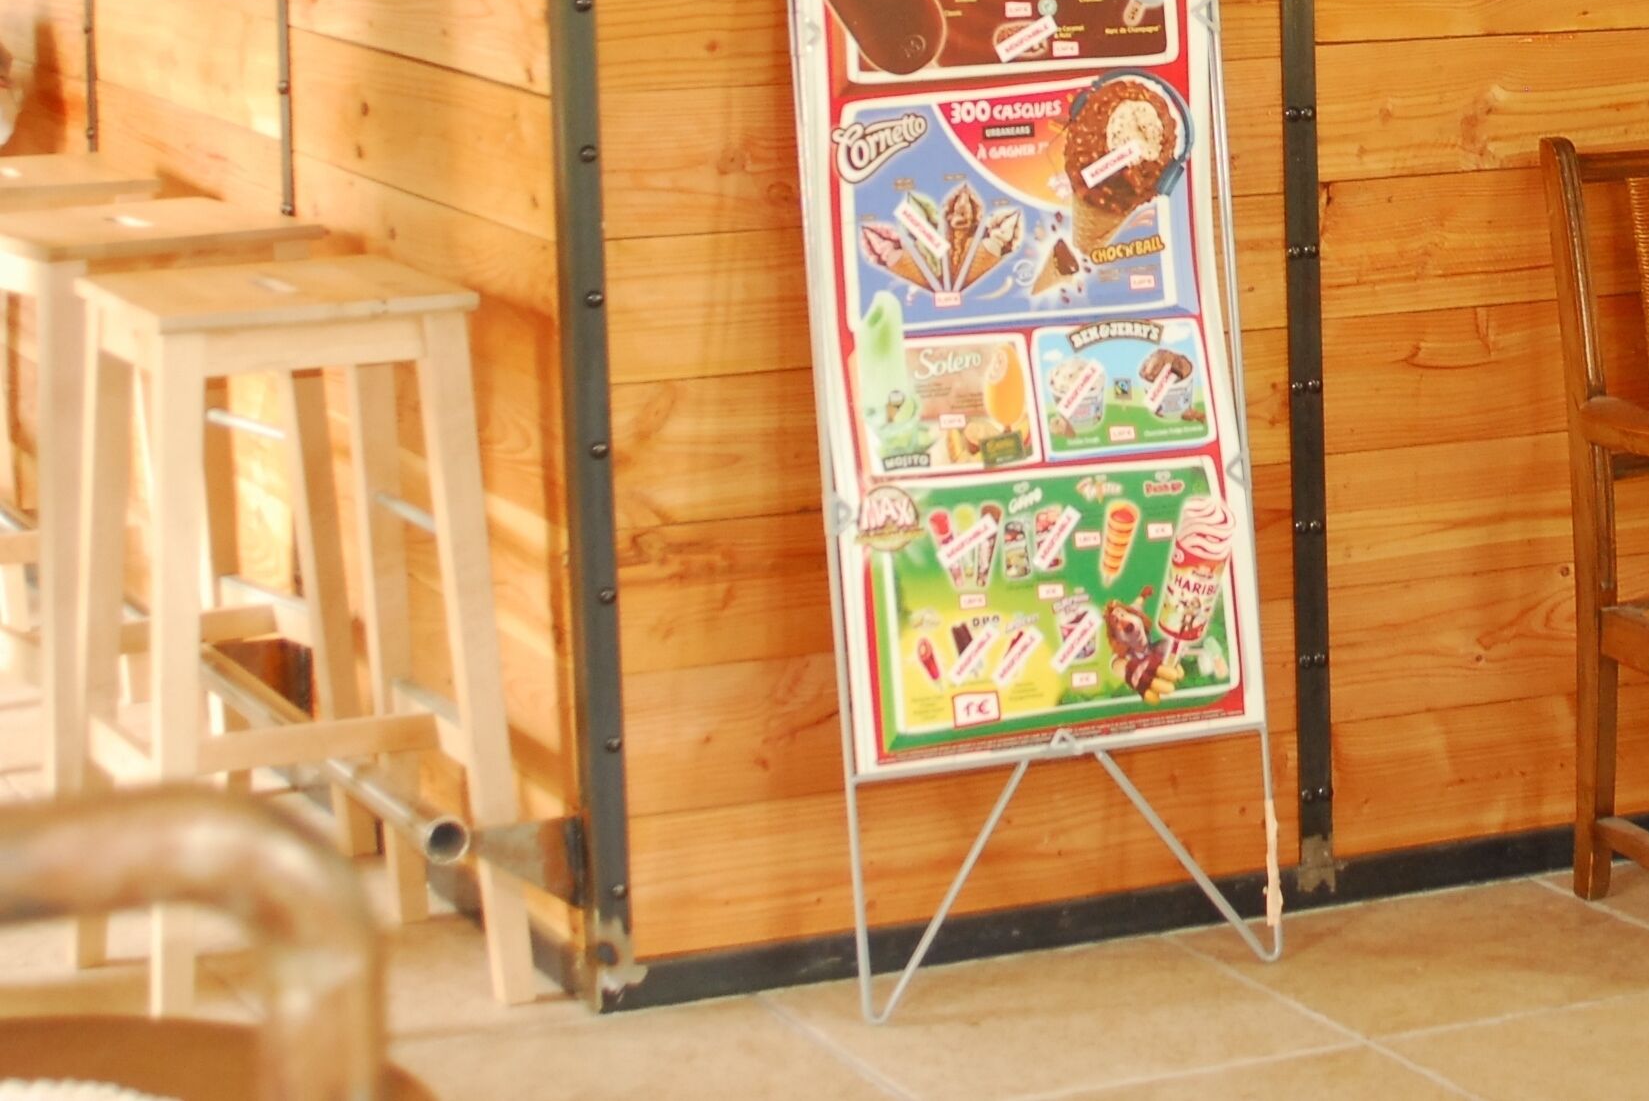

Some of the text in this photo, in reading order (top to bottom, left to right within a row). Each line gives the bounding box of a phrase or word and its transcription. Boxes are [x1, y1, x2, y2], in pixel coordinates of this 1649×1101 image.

[950, 99, 1062, 124] 300 CASQUES
[832, 114, 928, 184] Cornetto
[988, 142, 1036, 160] GAGNER
[913, 348, 983, 380] Solero
[884, 453, 929, 469] MOJITO
[859, 496, 919, 534] MAX
